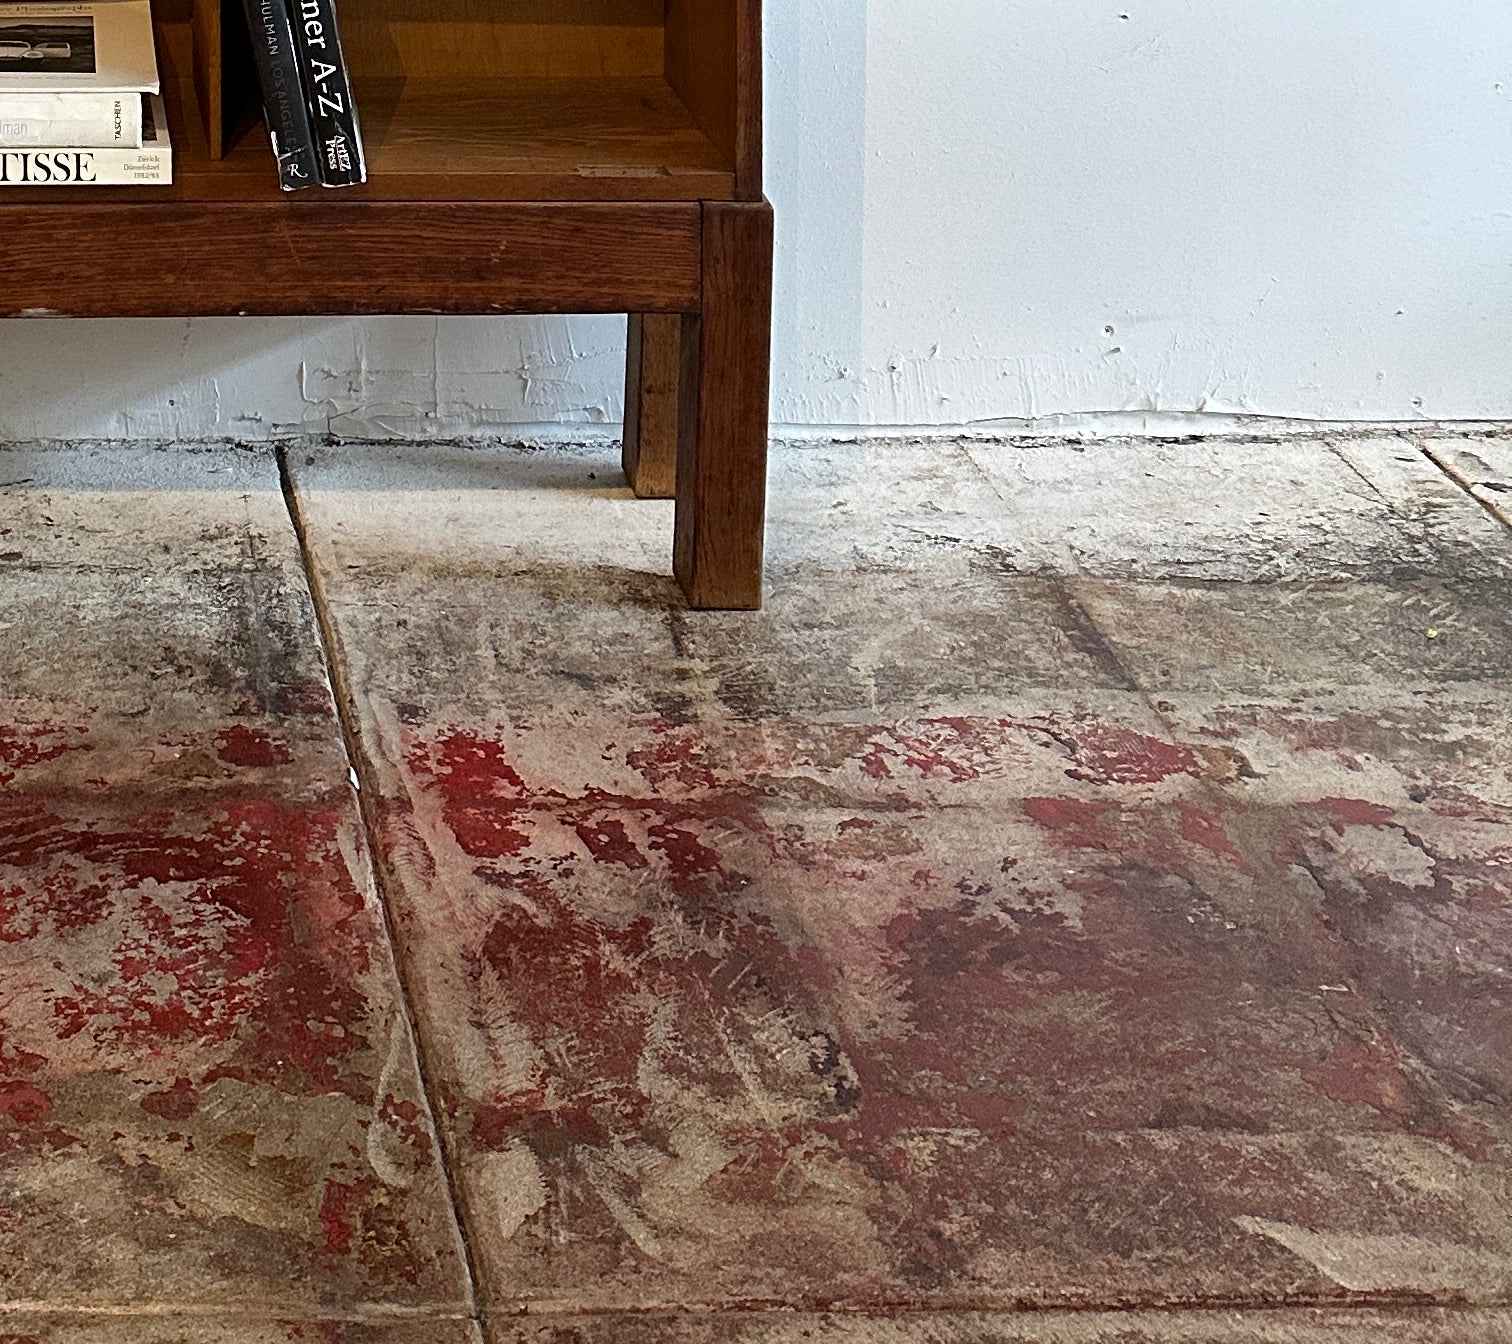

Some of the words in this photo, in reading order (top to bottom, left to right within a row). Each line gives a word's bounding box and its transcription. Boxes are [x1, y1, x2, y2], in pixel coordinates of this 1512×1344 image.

[270, 60, 285, 88] LOS
[310, 58, 344, 118] A-Z
[114, 100, 122, 141] TASCHEN
[325, 139, 338, 170] Press
